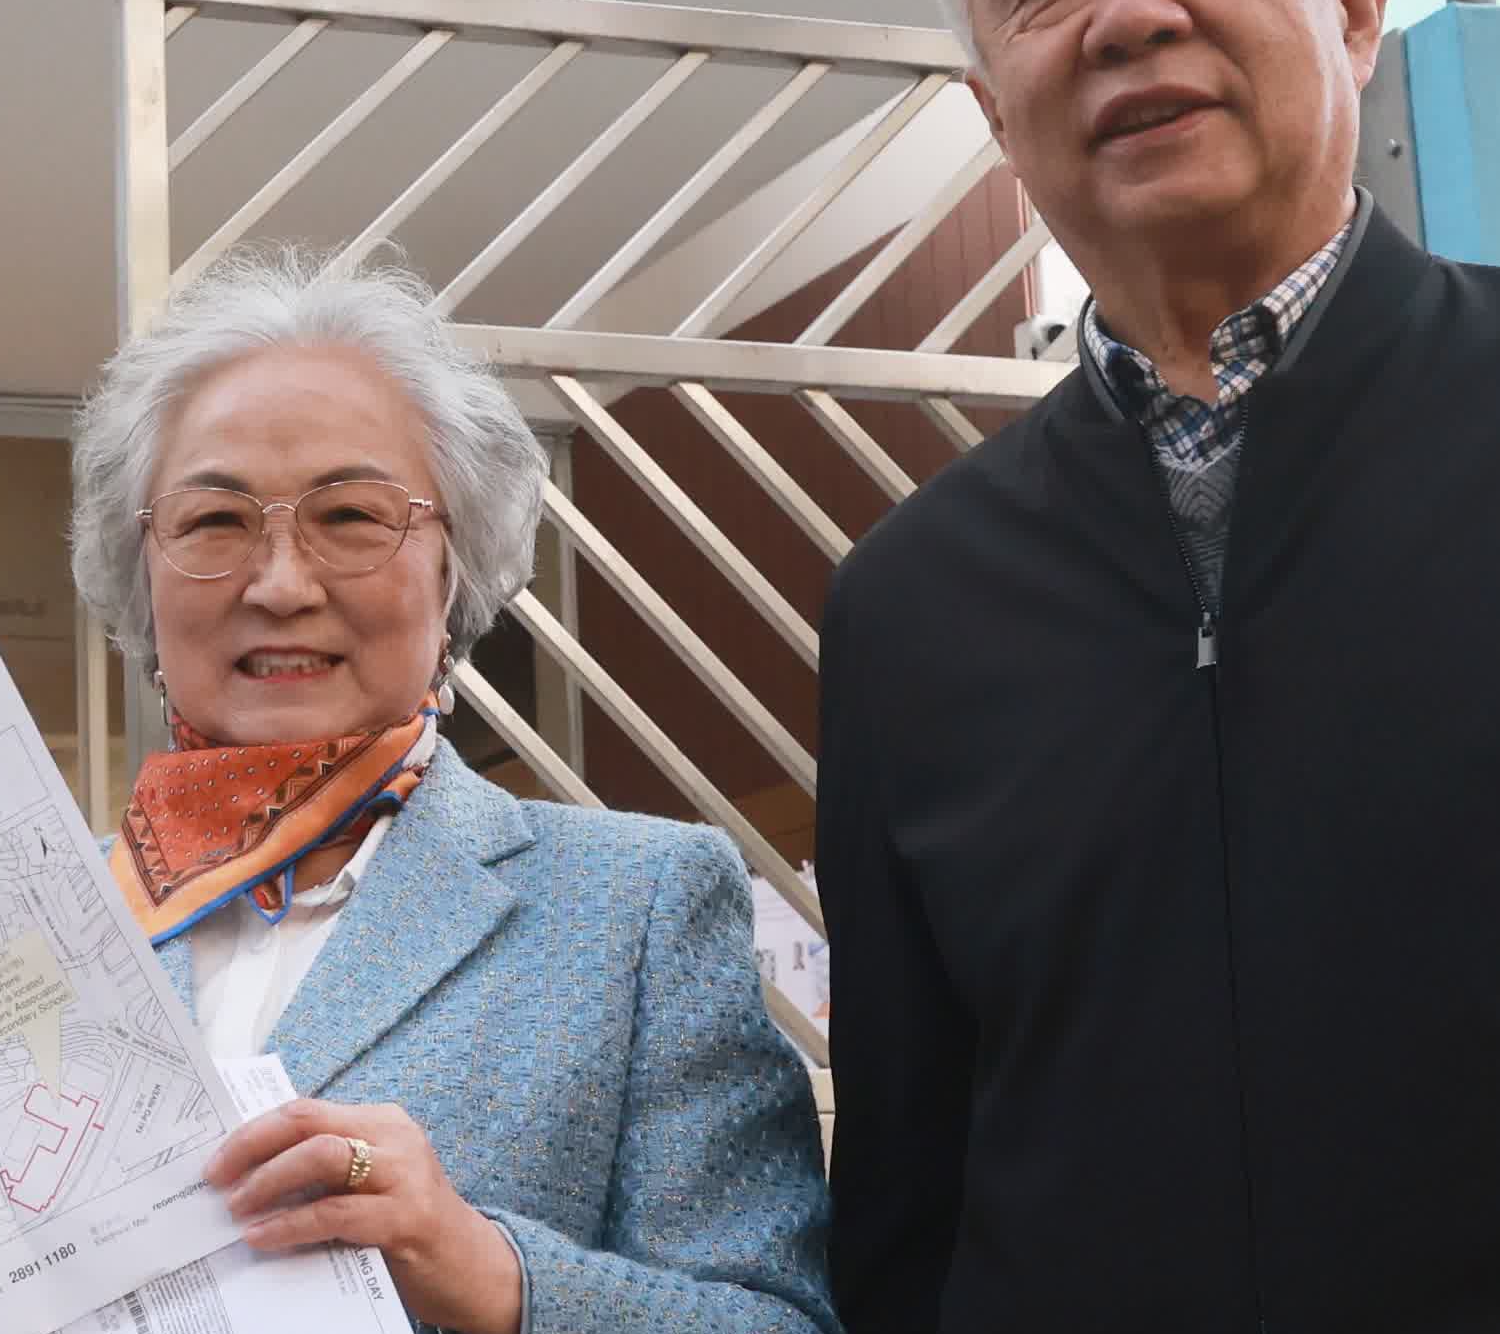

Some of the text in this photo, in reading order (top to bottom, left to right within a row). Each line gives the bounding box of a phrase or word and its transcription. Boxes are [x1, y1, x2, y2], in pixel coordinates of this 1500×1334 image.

[7, 1240, 78, 1285] 2891 1180
[366, 1275, 386, 1302] DAY
